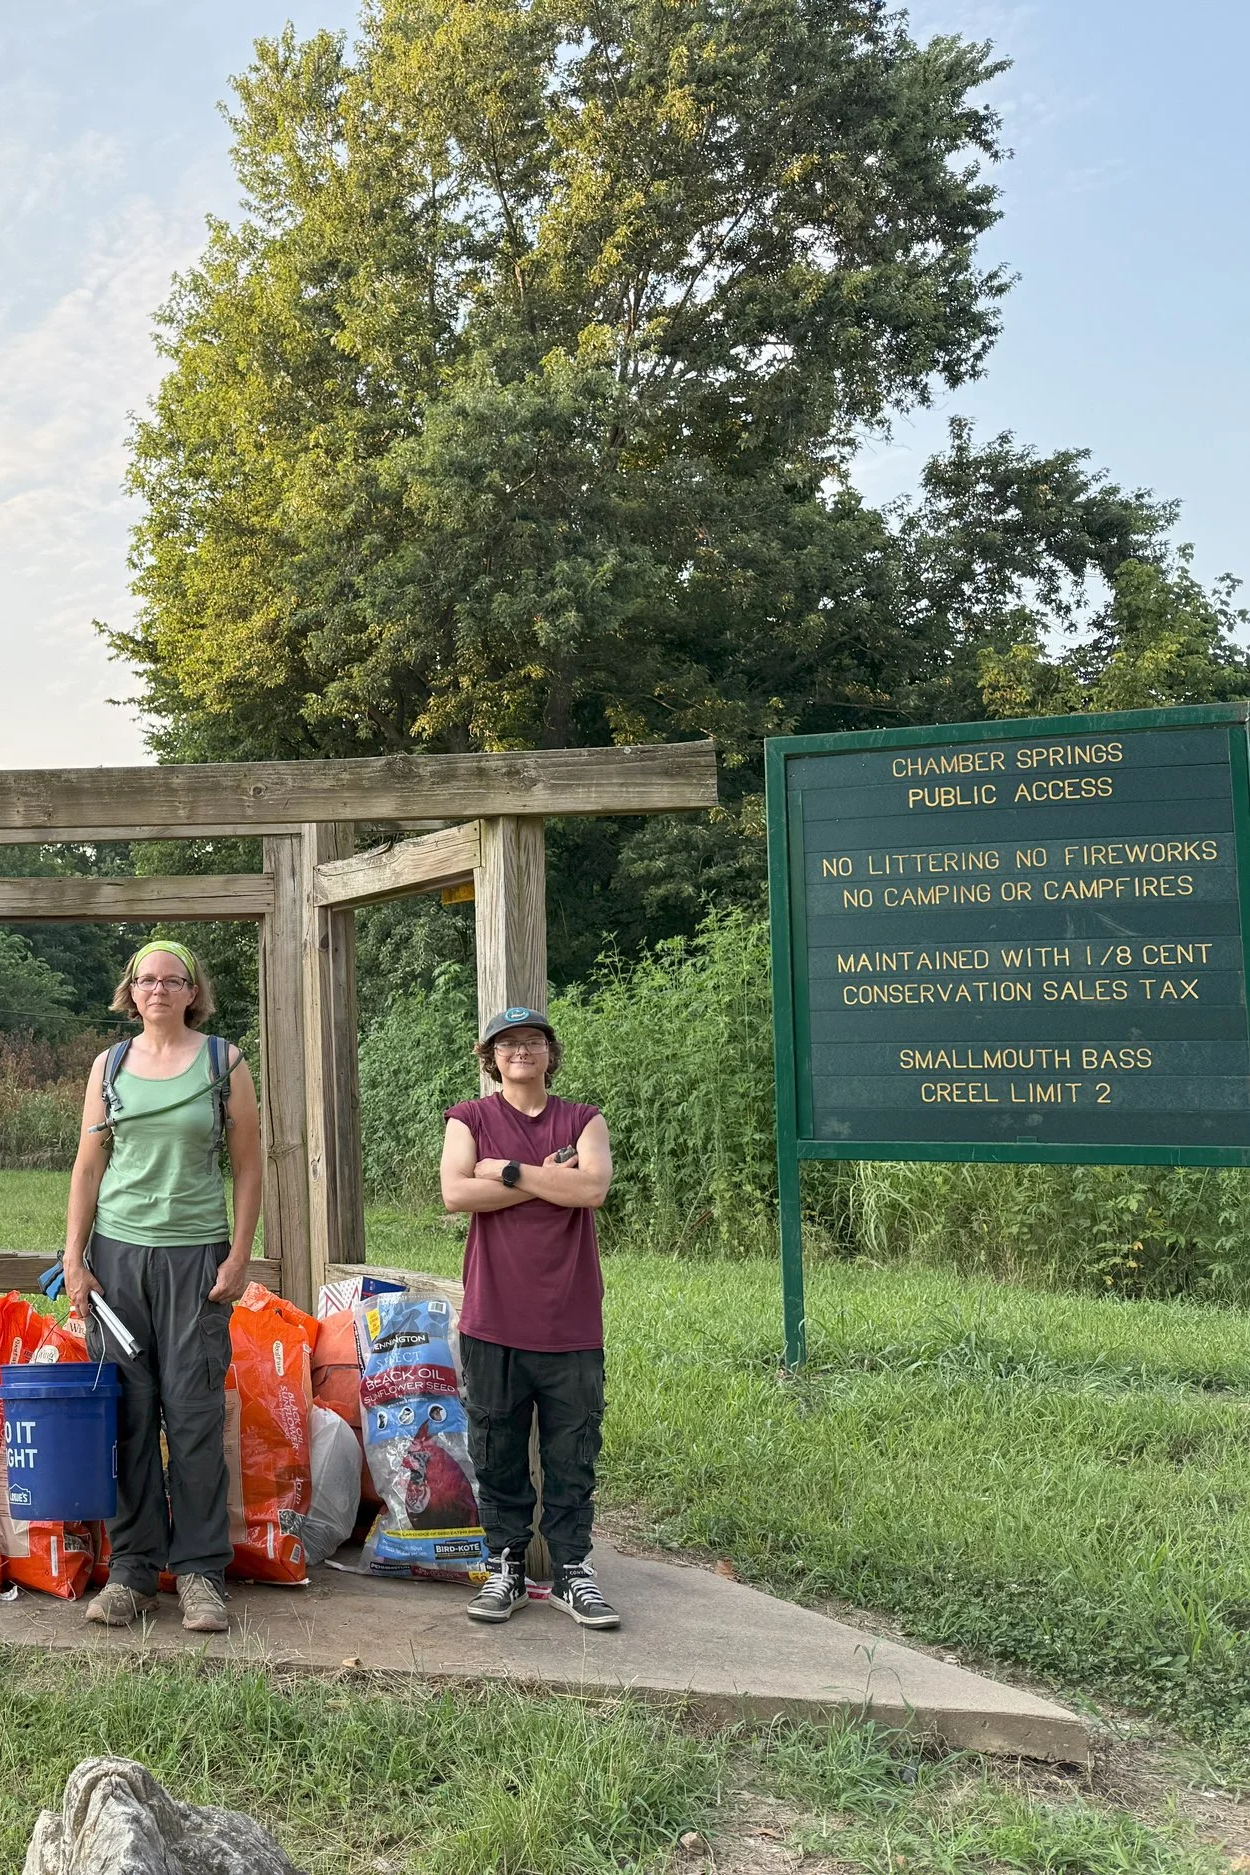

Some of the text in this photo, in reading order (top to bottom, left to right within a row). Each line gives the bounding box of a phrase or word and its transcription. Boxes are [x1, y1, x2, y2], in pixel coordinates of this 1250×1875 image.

[892, 742, 1123, 778] CHAMBER SPRINGS
[908, 777, 1113, 808] PUBLIC ACCESS
[822, 840, 1218, 877] NO LITTERING NO FIREWORKS
[843, 875, 1194, 908] NO CAMPING OR CAMPFIRES
[837, 943, 1213, 973] MAINTAINED WITH 1/8 CENT
[843, 978, 1199, 1005] CONSERVATION SALES TAX
[899, 1047, 1152, 1070] SMALLMOUTH BASS
[921, 1082, 1111, 1103] CREEL LIMIT 2
[418, 1368, 445, 1381] OIL
[363, 1381, 423, 1405] SUNFLOWER
[426, 1382, 455, 1393] SEED
[280, 1385, 299, 1449] SUNFLOWER
[287, 1392, 302, 1425] BLACK
[4, 1421, 36, 1444] O IT
[6, 1448, 38, 1468] GHT
[435, 1543, 480, 1553] BIRD-KOTE
